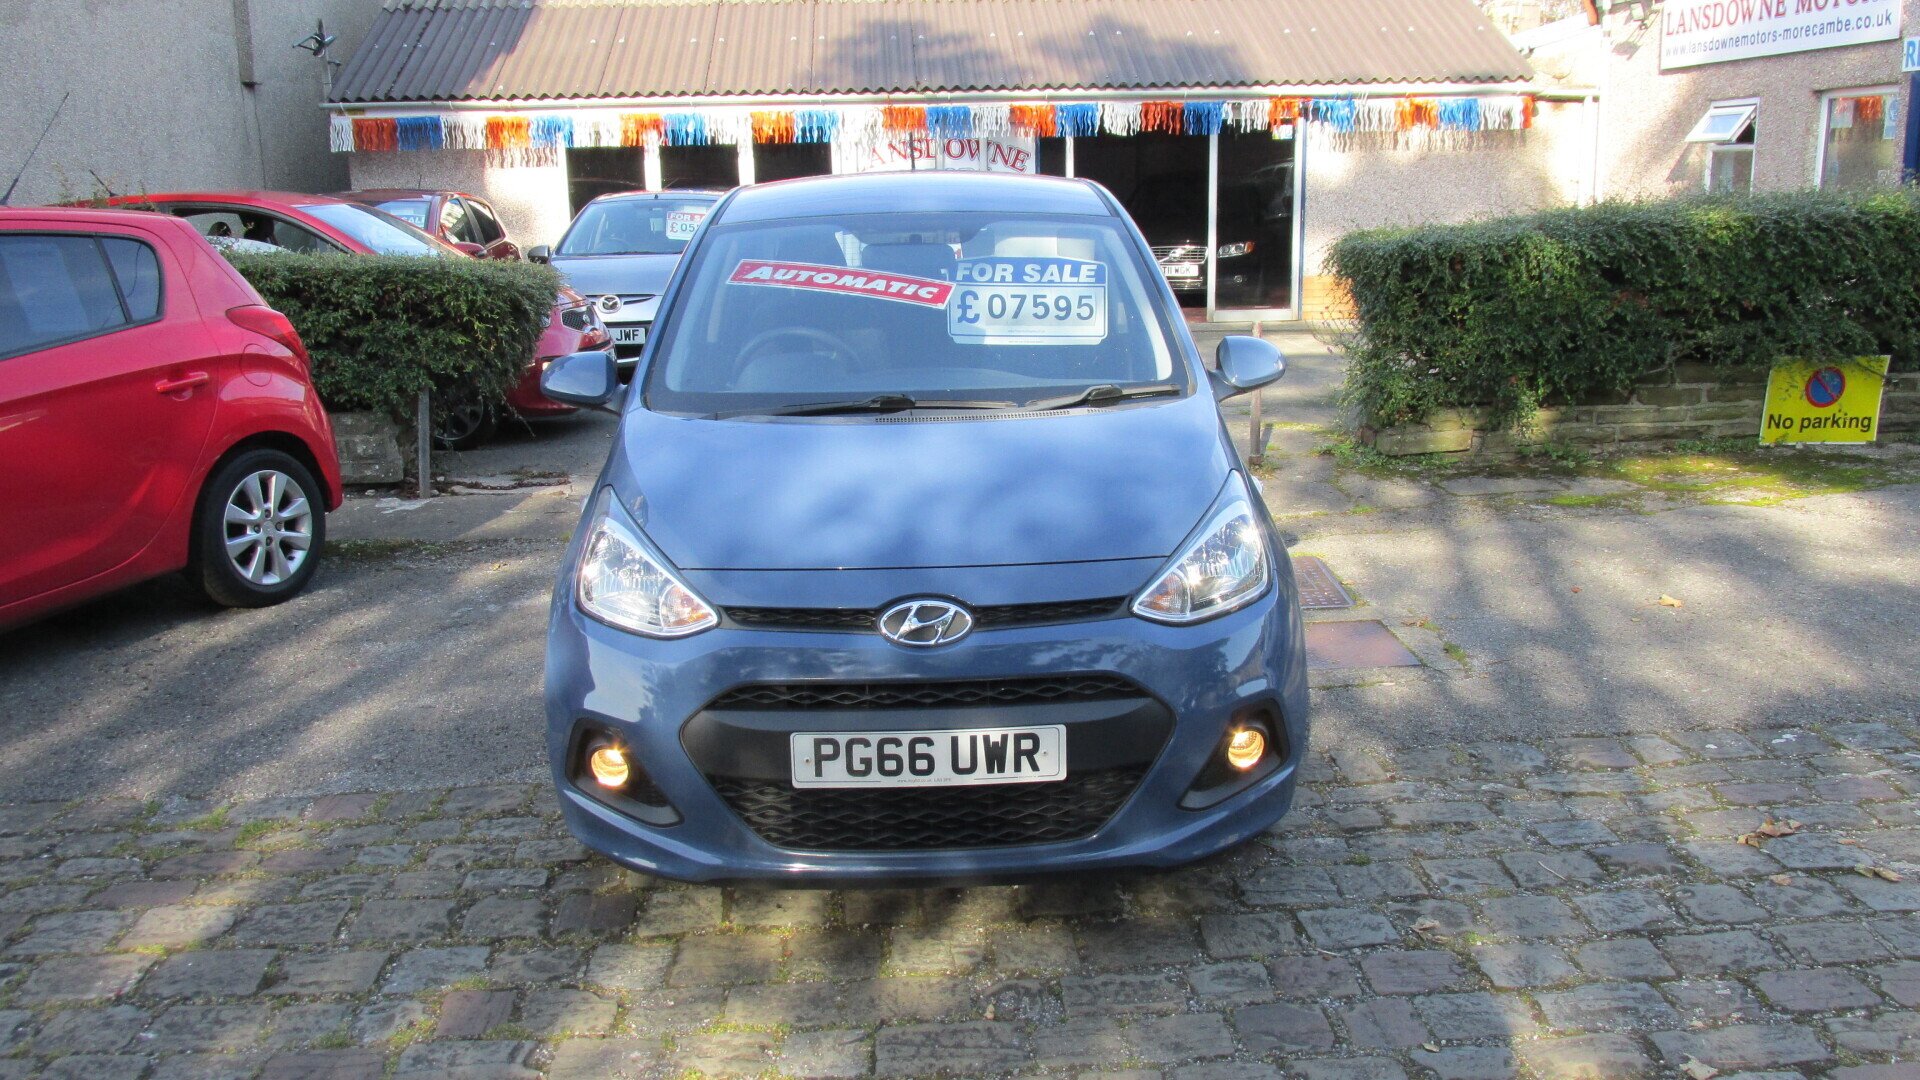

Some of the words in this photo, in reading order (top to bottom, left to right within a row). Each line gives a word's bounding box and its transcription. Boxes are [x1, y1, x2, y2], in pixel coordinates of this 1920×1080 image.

[1665, 9, 1893, 57] www.lansdownemotors-morecambe.co.uk
[1666, 0, 1787, 36] LANSDOWNE
[743, 265, 940, 299] AUTOMATIC
[956, 262, 1014, 283] FOR
[1022, 263, 1098, 284] SALE
[615, 329, 639, 341] JWF
[1767, 414, 1794, 430] No
[1799, 413, 1872, 433] parking
[813, 736, 936, 778] PG66
[950, 732, 1041, 776] UWR
